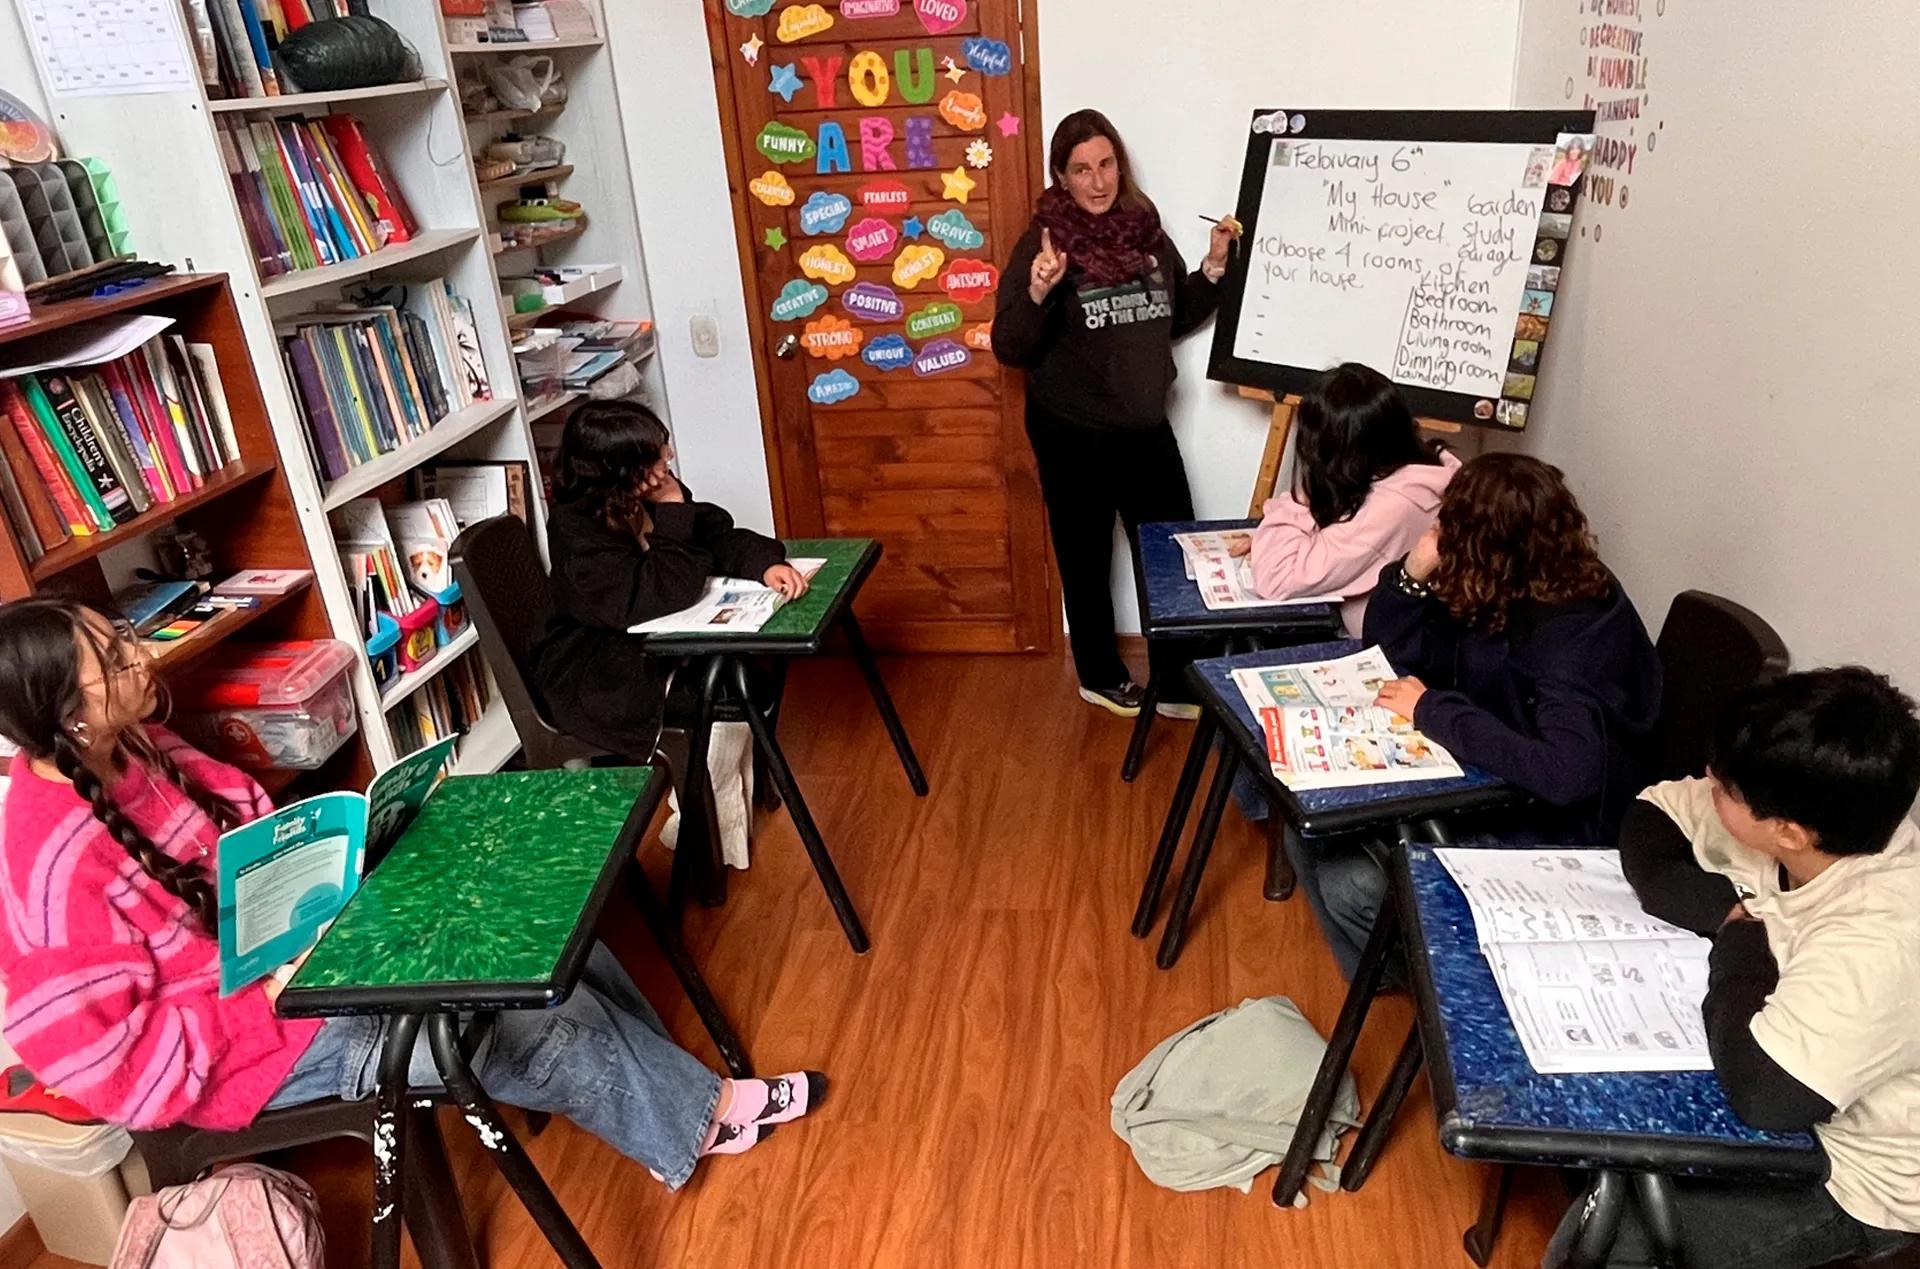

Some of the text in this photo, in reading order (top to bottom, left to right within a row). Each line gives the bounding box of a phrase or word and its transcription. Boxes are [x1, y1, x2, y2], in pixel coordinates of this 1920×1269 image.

[919, 0, 959, 22] LOVED
[1600, 23, 1643, 56] CREATIVE
[968, 43, 1007, 69] Helpful
[800, 47, 936, 109] YOU
[1599, 57, 1648, 90] HUMBLE
[1596, 97, 1640, 123] THANKFUL
[763, 135, 807, 154] FUNNY
[816, 116, 937, 175] ARE
[1593, 135, 1637, 176] HAPPY
[1293, 142, 1379, 183] February
[863, 191, 908, 204] FEARLESS
[1591, 174, 1615, 207] YOU
[805, 201, 848, 225] SPECIAL
[1467, 189, 1536, 219] Garden
[851, 228, 890, 253] SMART
[931, 220, 974, 245] BRAVE
[1462, 215, 1515, 252] Study
[806, 256, 848, 276] HONEST
[897, 252, 936, 281] HONEST
[1334, 241, 1352, 268] 4
[1457, 244, 1523, 276] Garage
[1309, 264, 1365, 292] house
[1419, 270, 1490, 295] Kitchen
[776, 288, 821, 315] CREATIVE
[849, 292, 898, 315] POSITIVE
[1081, 298, 1110, 316] THE
[1111, 292, 1149, 310] DARK
[1414, 288, 1498, 314] Bedroom
[1085, 313, 1107, 329] OF
[1109, 308, 1135, 325] THE
[1410, 307, 1492, 340] Bathroom
[808, 330, 853, 347] STRONG
[868, 347, 904, 361] UNIQUE
[917, 349, 967, 373] VALUED
[71, 407, 105, 467] Children's
